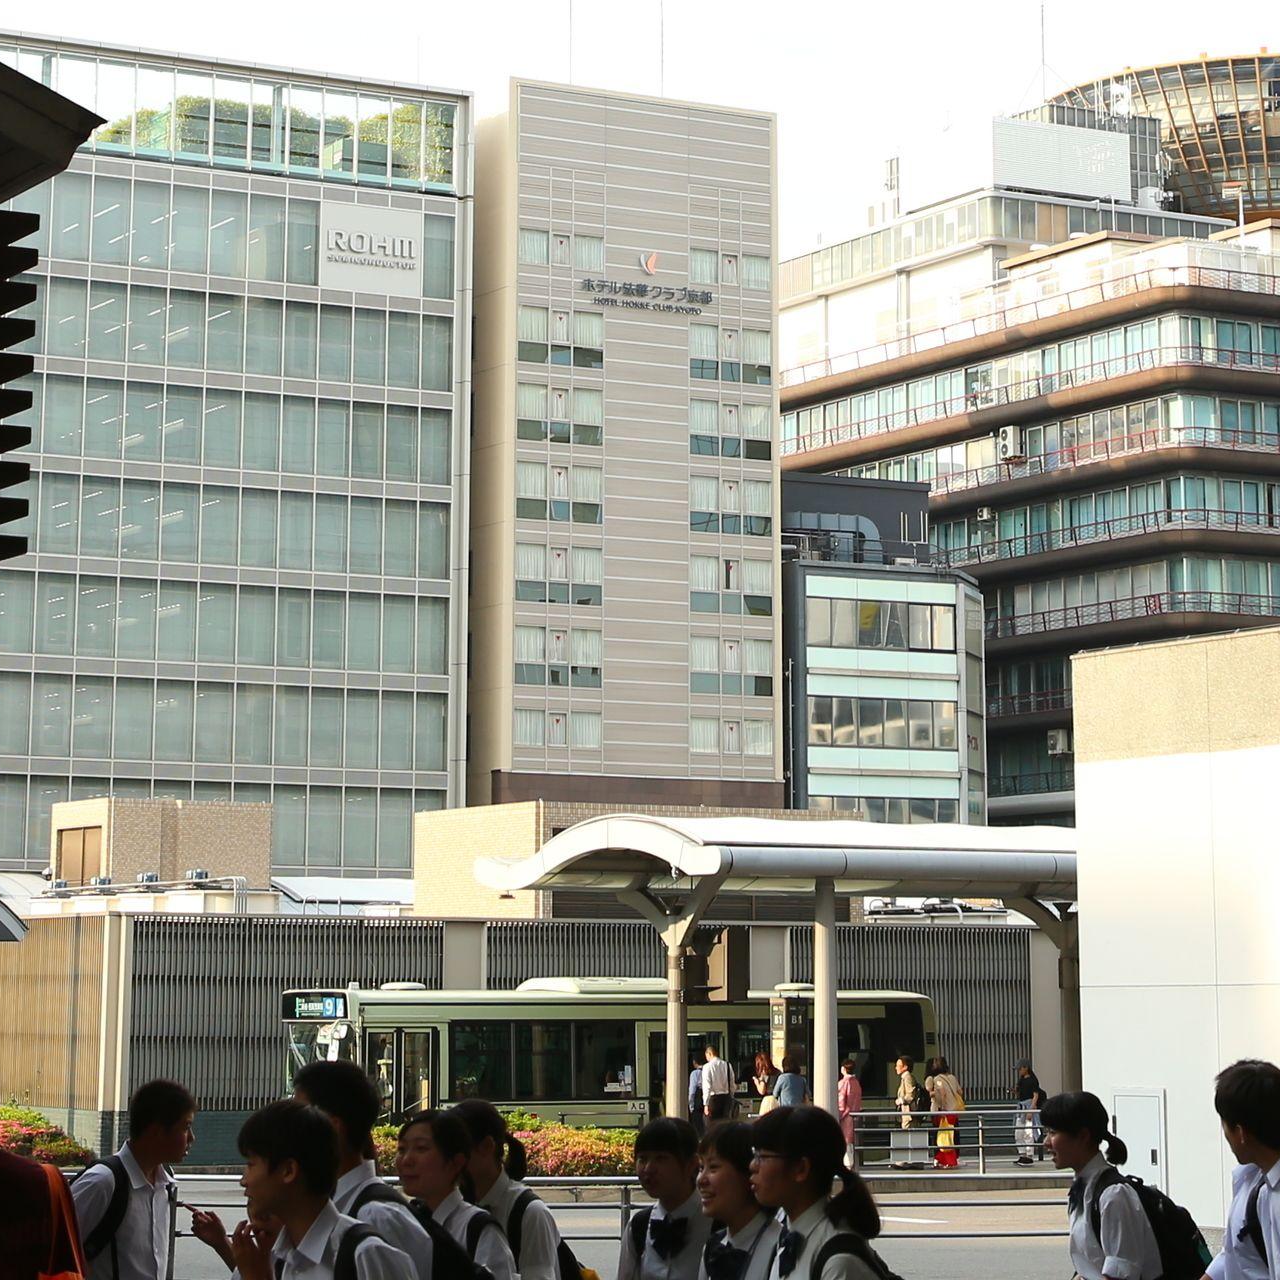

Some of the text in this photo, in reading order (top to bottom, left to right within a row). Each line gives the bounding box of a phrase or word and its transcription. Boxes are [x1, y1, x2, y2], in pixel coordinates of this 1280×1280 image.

[327, 228, 417, 260] ROHM
[593, 296, 702, 315] HOTEL HOKKE CLUB KYOTO
[325, 998, 333, 1015] 9
